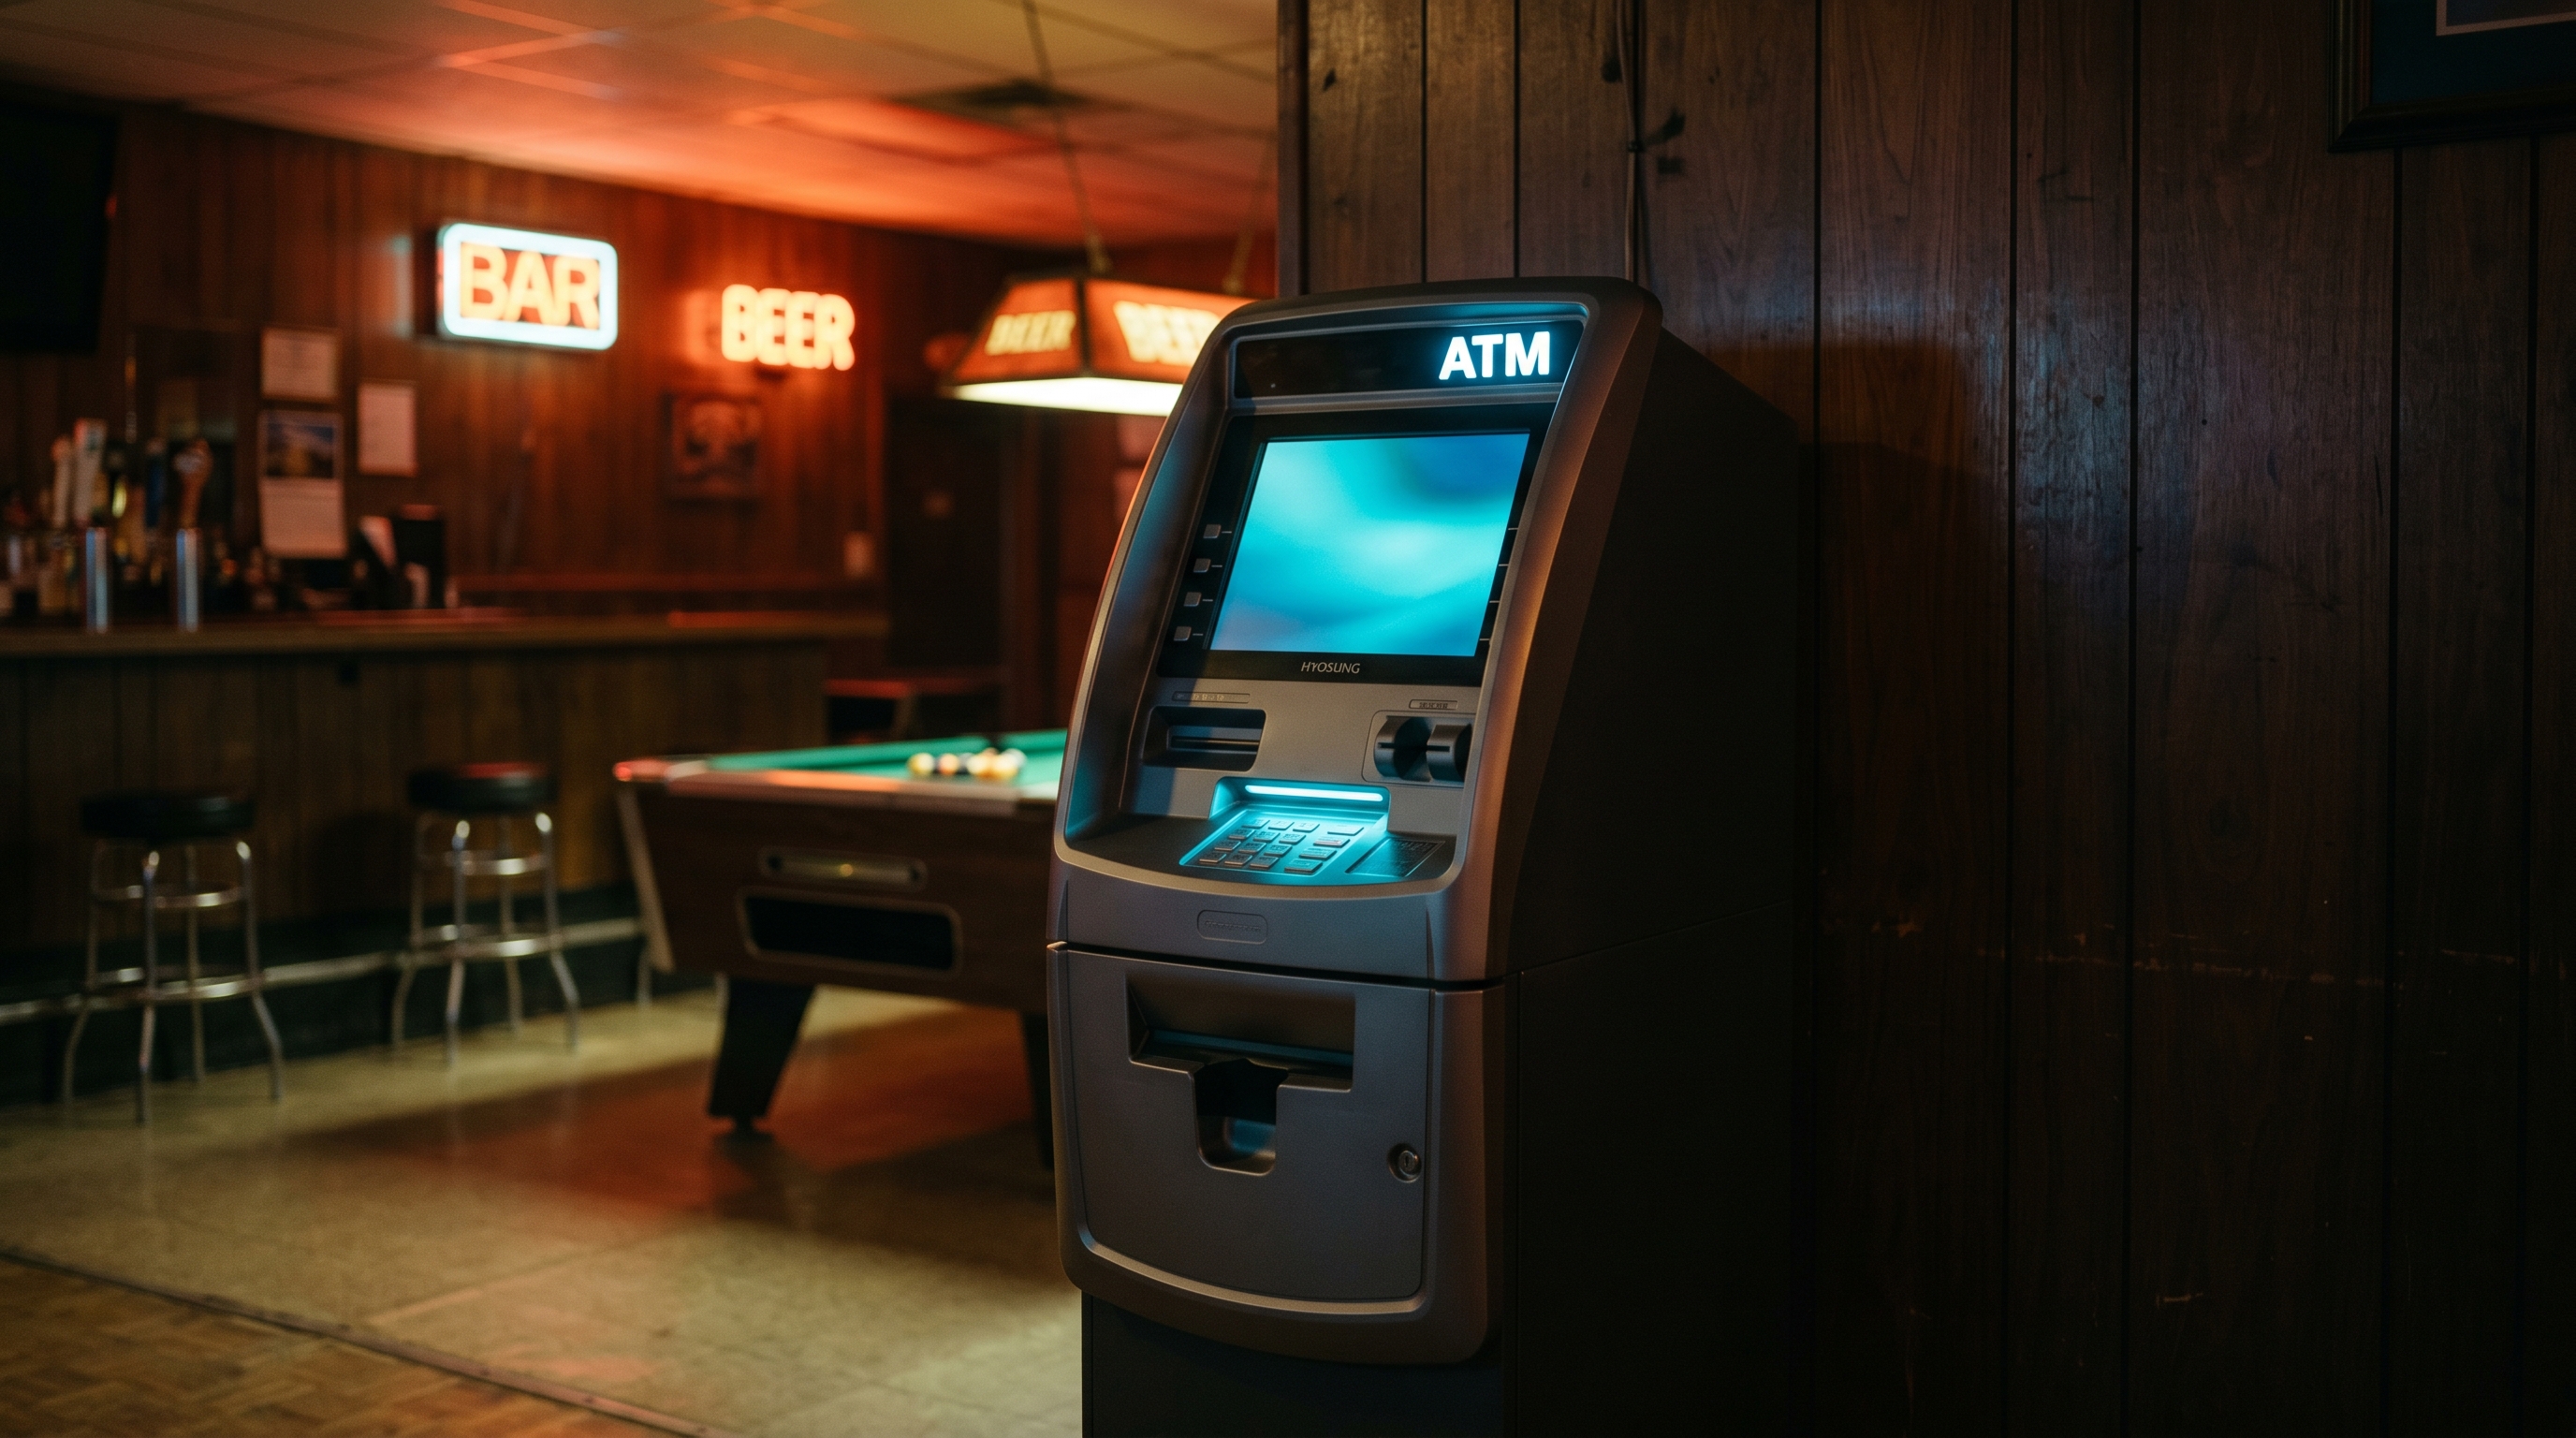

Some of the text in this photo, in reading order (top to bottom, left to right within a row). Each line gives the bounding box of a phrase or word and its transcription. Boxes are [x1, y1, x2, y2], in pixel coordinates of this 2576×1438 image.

[459, 241, 601, 330] BAR
[722, 284, 856, 371] BEER
[1439, 330, 1550, 380] ATM
[1300, 661, 1361, 674] HYOSUNG
